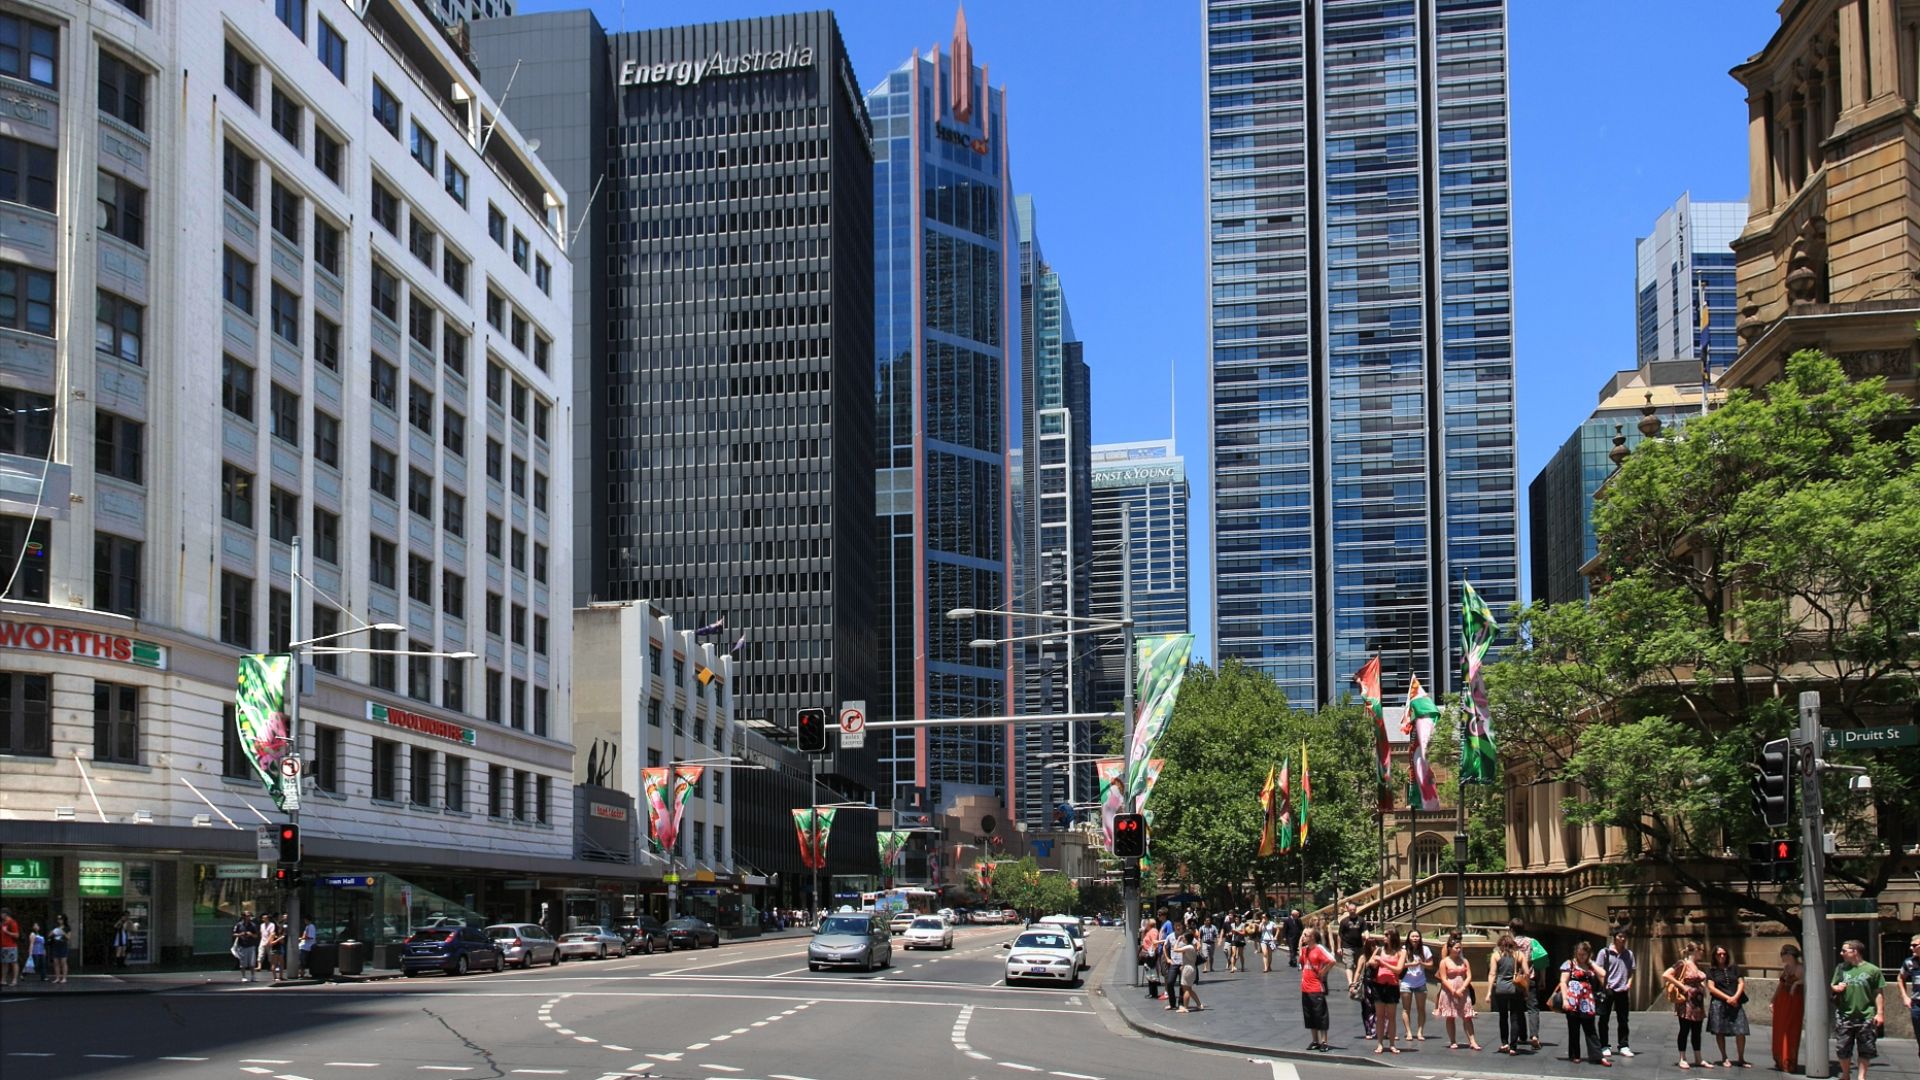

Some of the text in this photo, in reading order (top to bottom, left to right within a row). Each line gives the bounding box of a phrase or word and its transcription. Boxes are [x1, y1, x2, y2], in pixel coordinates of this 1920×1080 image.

[618, 42, 814, 87] EnergyAustralia
[1124, 470, 1132, 480] &
[1133, 467, 1175, 480] YOUNG
[0, 622, 132, 661] WORTHS
[387, 707, 464, 742] WOOLWORTHS
[1846, 729, 1900, 742] Druitt St
